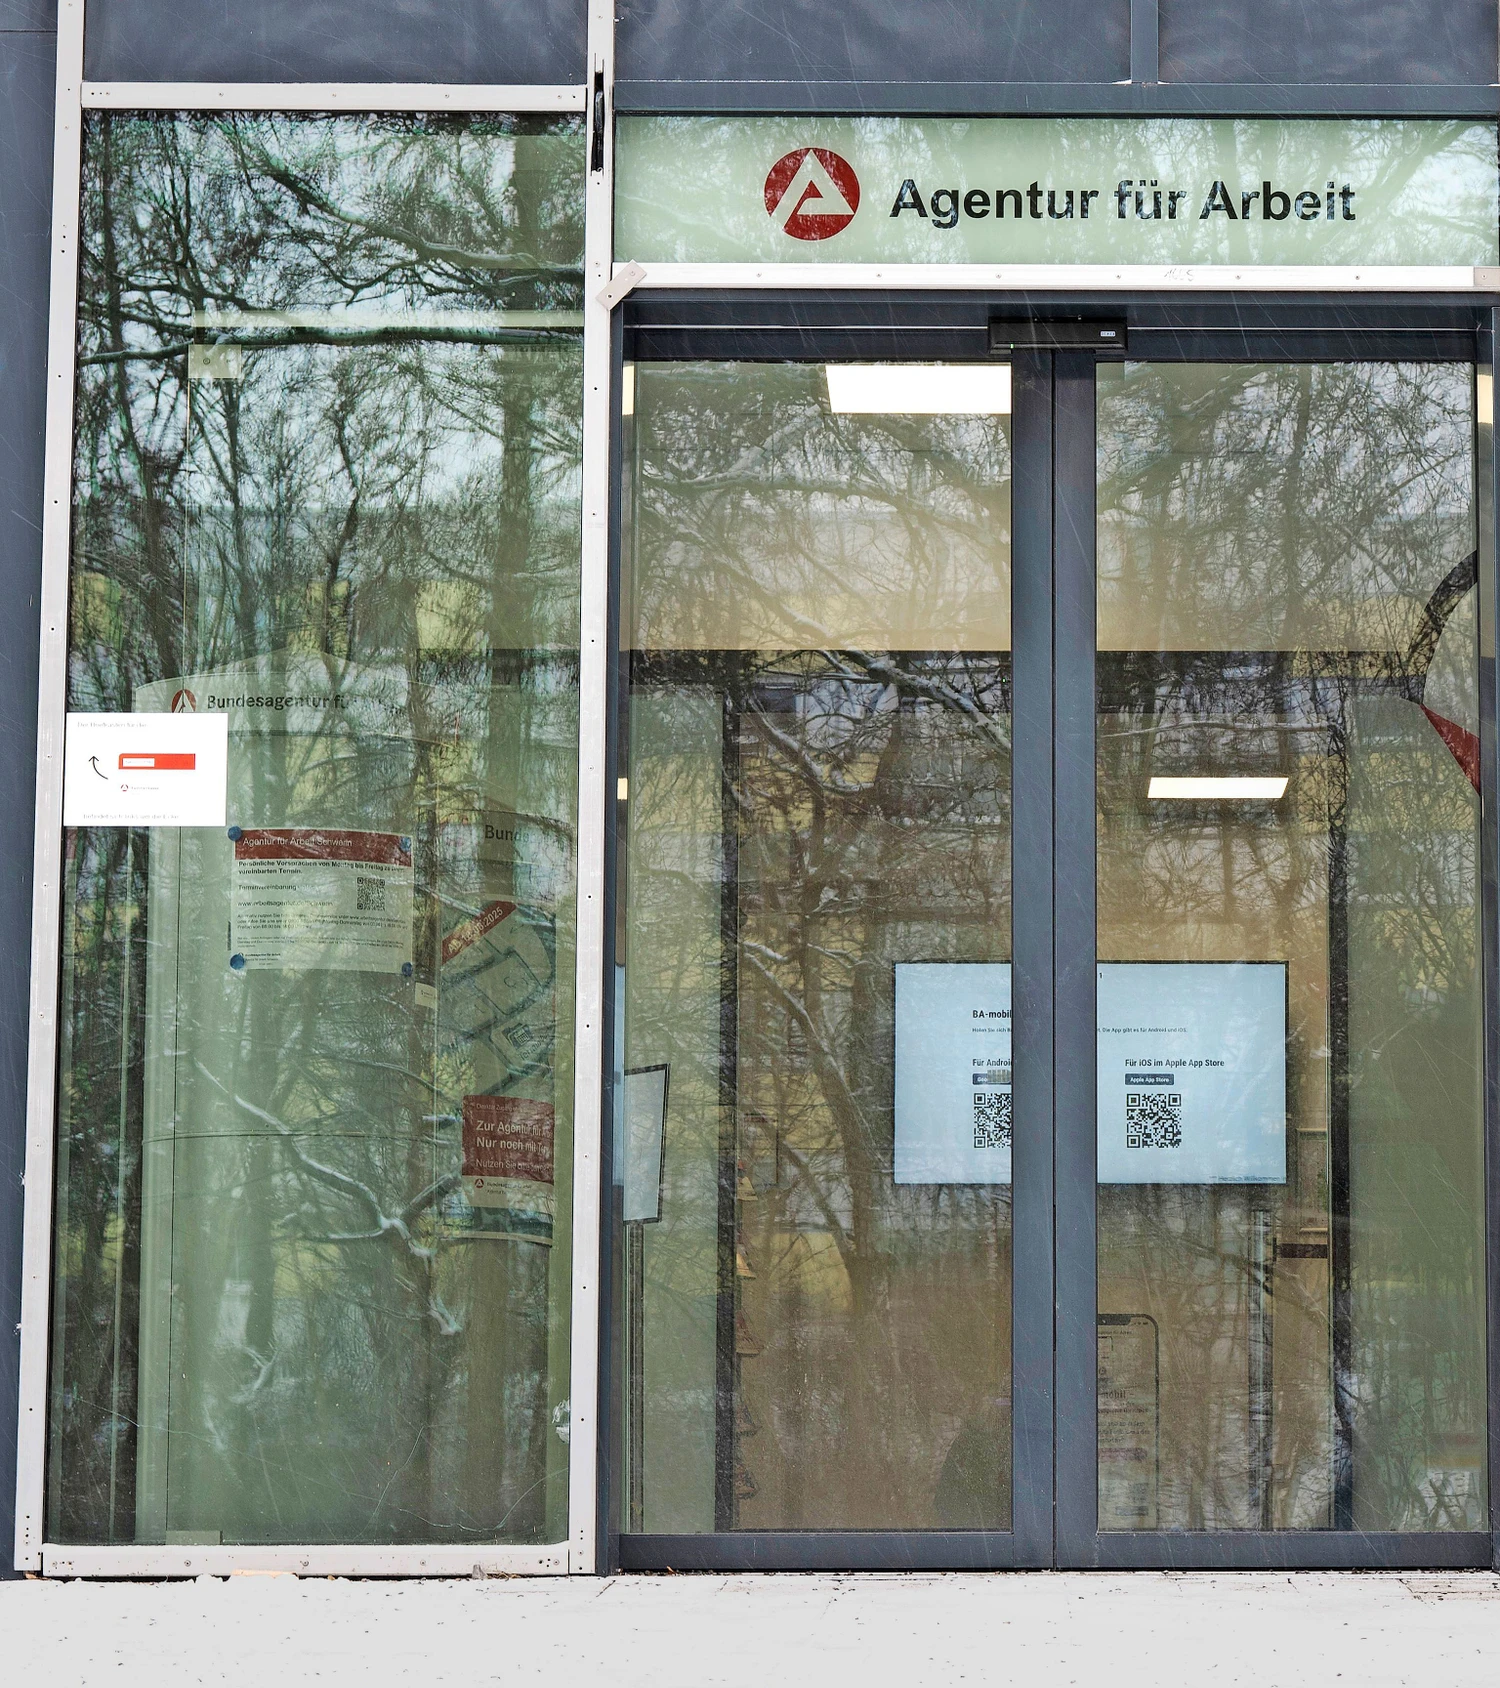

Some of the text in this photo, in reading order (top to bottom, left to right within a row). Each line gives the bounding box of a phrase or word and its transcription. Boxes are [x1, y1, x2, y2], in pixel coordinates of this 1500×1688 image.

[889, 179, 1356, 229] Agentur für Arbeit
[207, 695, 326, 711] Bundesagentur
[243, 838, 277, 847] Agentur
[972, 1009, 1012, 1018] BA-mobil
[972, 1058, 1011, 1066] Für Androi
[1125, 1058, 1225, 1069] Für iOS im Apple App Store
[476, 1119, 495, 1131] Zur
[476, 1136, 497, 1148] Nur
[500, 1139, 523, 1151] noch
[476, 1158, 504, 1169] Nutzen
